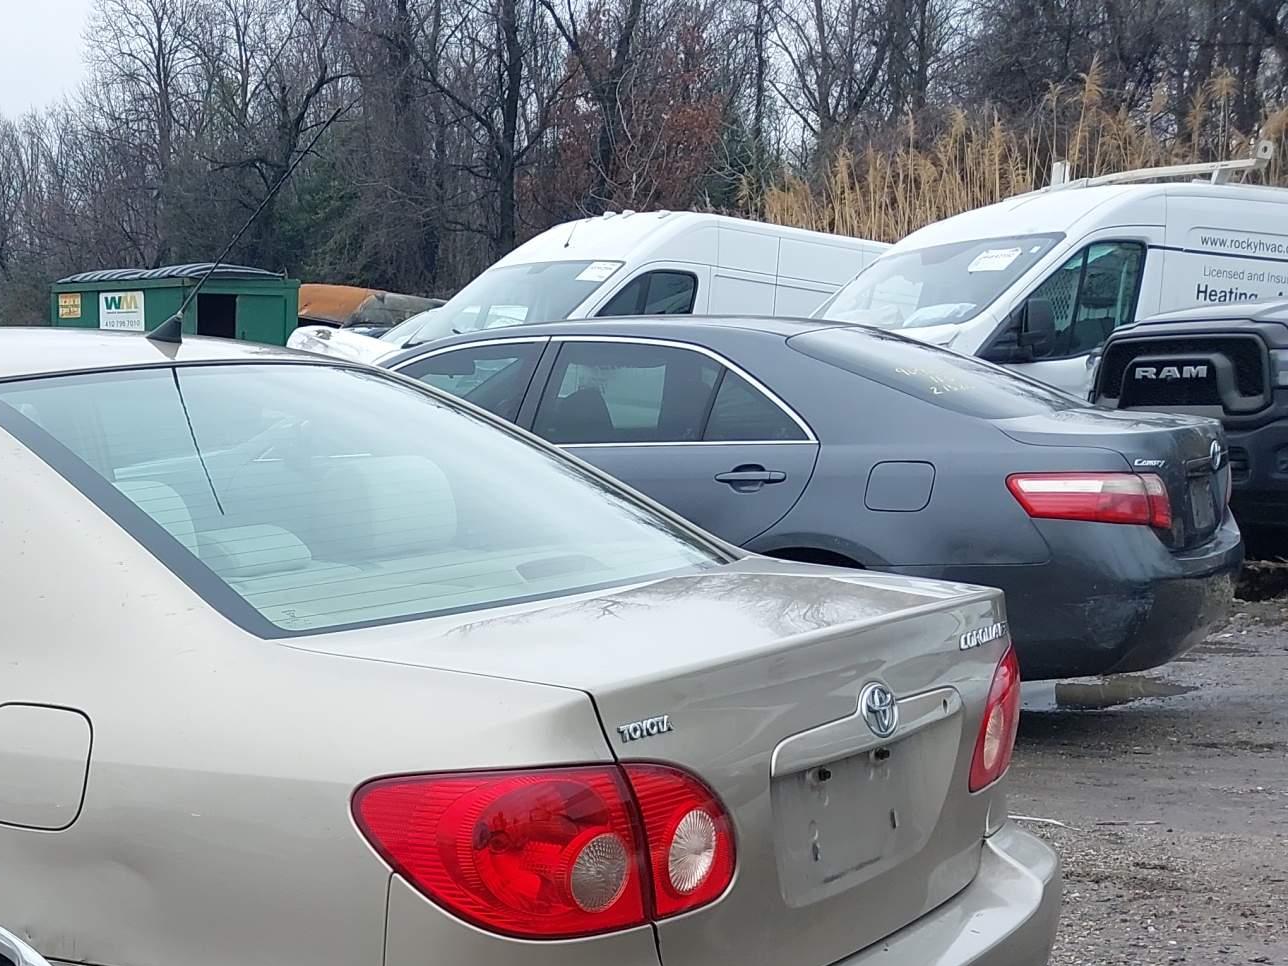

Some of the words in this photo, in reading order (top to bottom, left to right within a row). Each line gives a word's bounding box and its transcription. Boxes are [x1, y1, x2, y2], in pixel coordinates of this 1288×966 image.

[1203, 265, 1245, 280] Licensed
[1247, 271, 1265, 282] and
[104, 296, 138, 310] WM
[1135, 366, 1207, 379] RAM
[1134, 459, 1165, 468] Camry
[617, 715, 674, 742] TOYOTA
